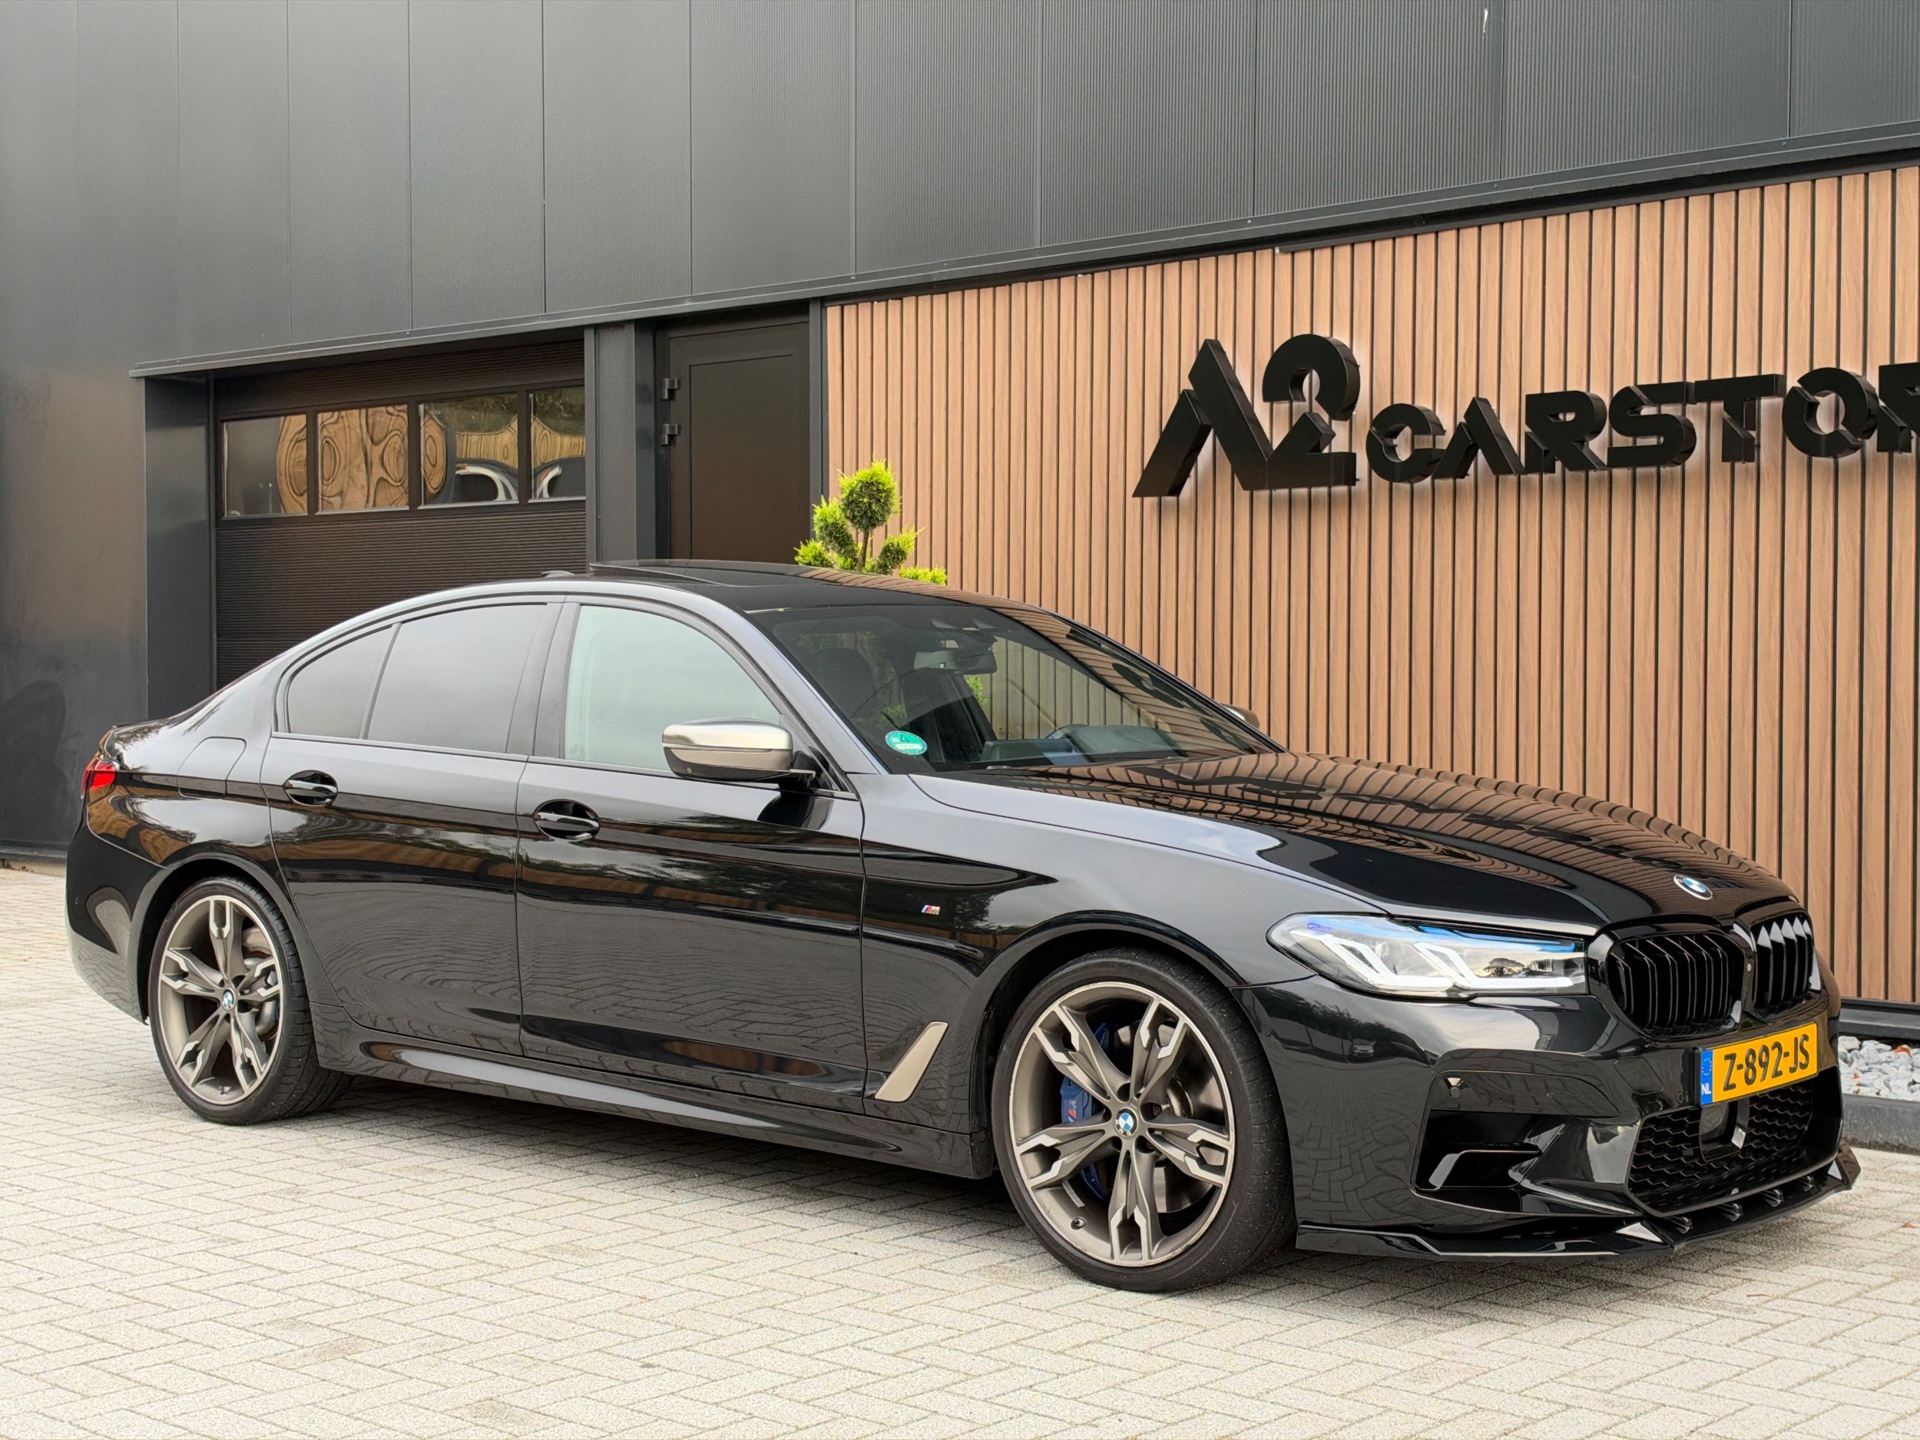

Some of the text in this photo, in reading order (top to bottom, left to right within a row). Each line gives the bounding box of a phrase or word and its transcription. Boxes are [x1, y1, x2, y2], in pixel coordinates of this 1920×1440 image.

[1132, 334, 1360, 498] A2
[1701, 1033, 1810, 1096] NL Z-892-JS
